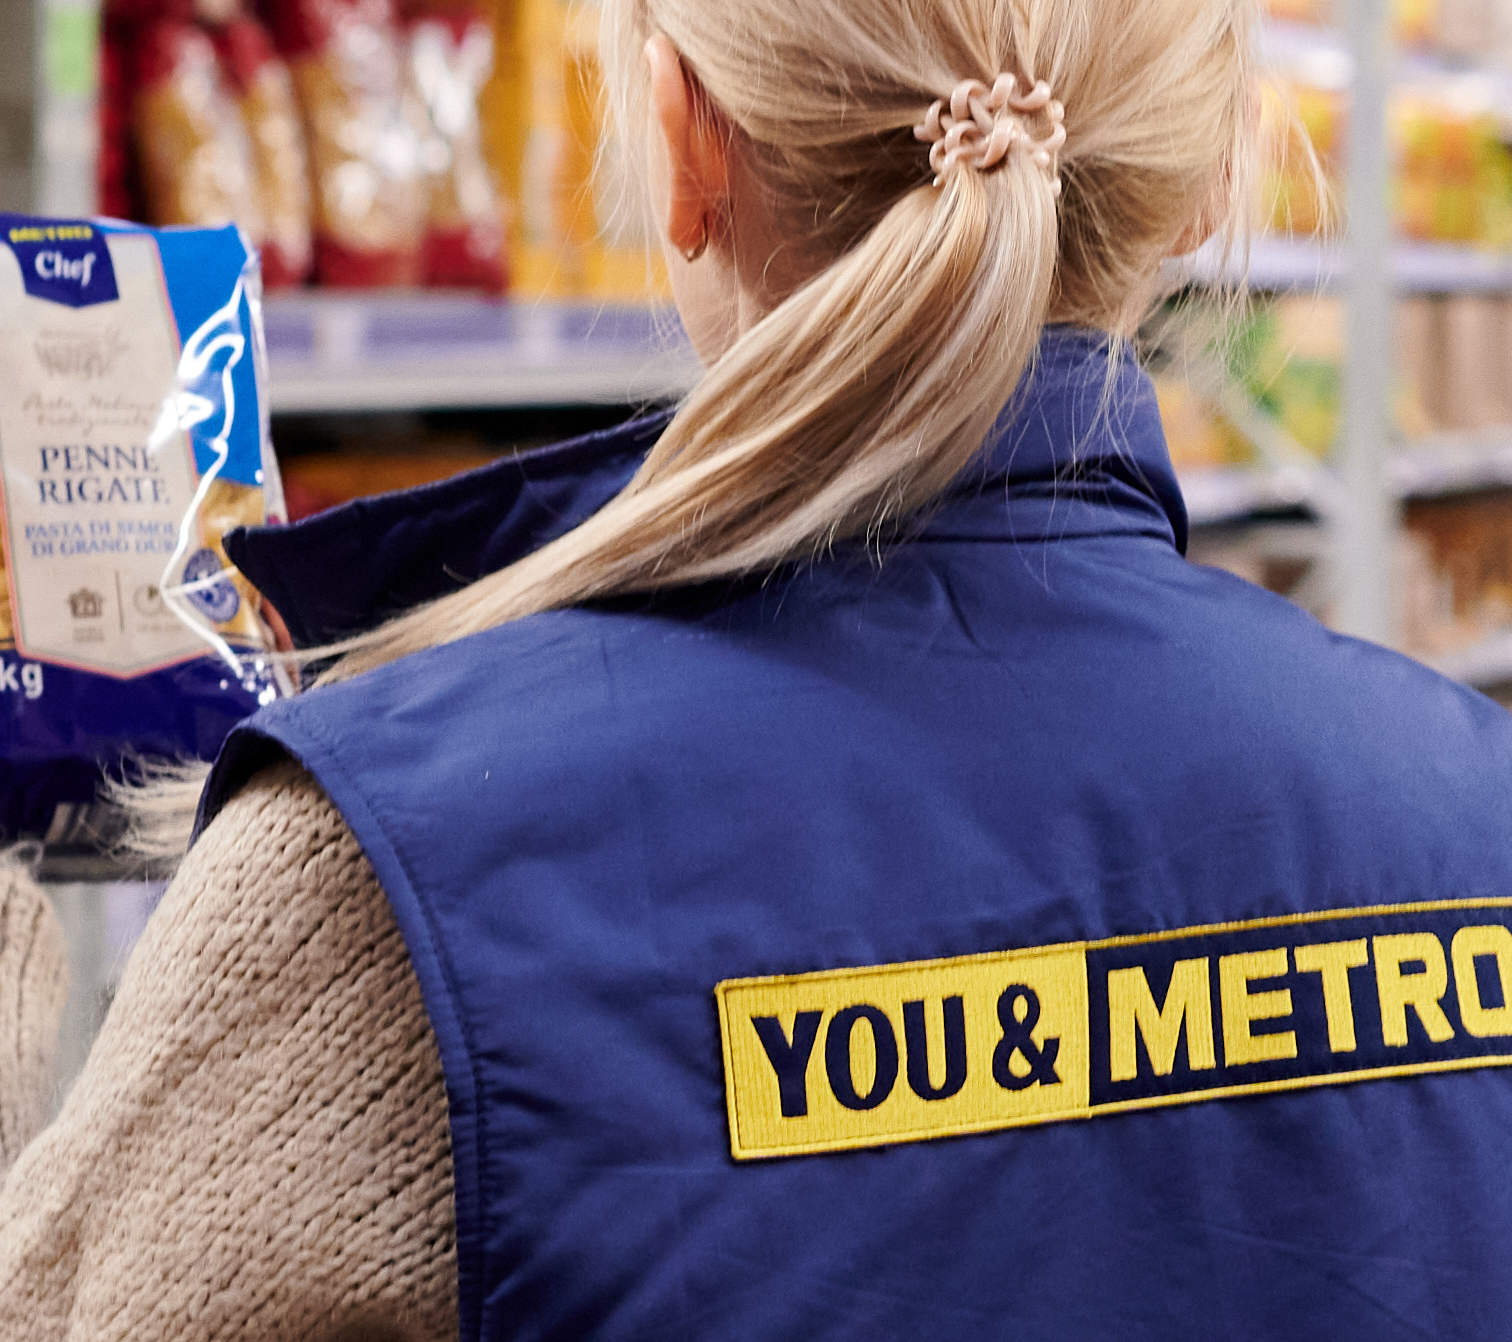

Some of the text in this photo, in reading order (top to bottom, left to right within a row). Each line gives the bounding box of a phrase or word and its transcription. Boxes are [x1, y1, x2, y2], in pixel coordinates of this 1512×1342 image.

[35, 250, 96, 287] Chef
[40, 443, 159, 472] PENNE
[39, 476, 171, 505] RIGATE
[24, 520, 177, 539] PASTA DI SEMOL
[31, 539, 176, 557] DI GRANO DUR
[749, 994, 967, 1118] YOU
[991, 983, 1062, 1092] &
